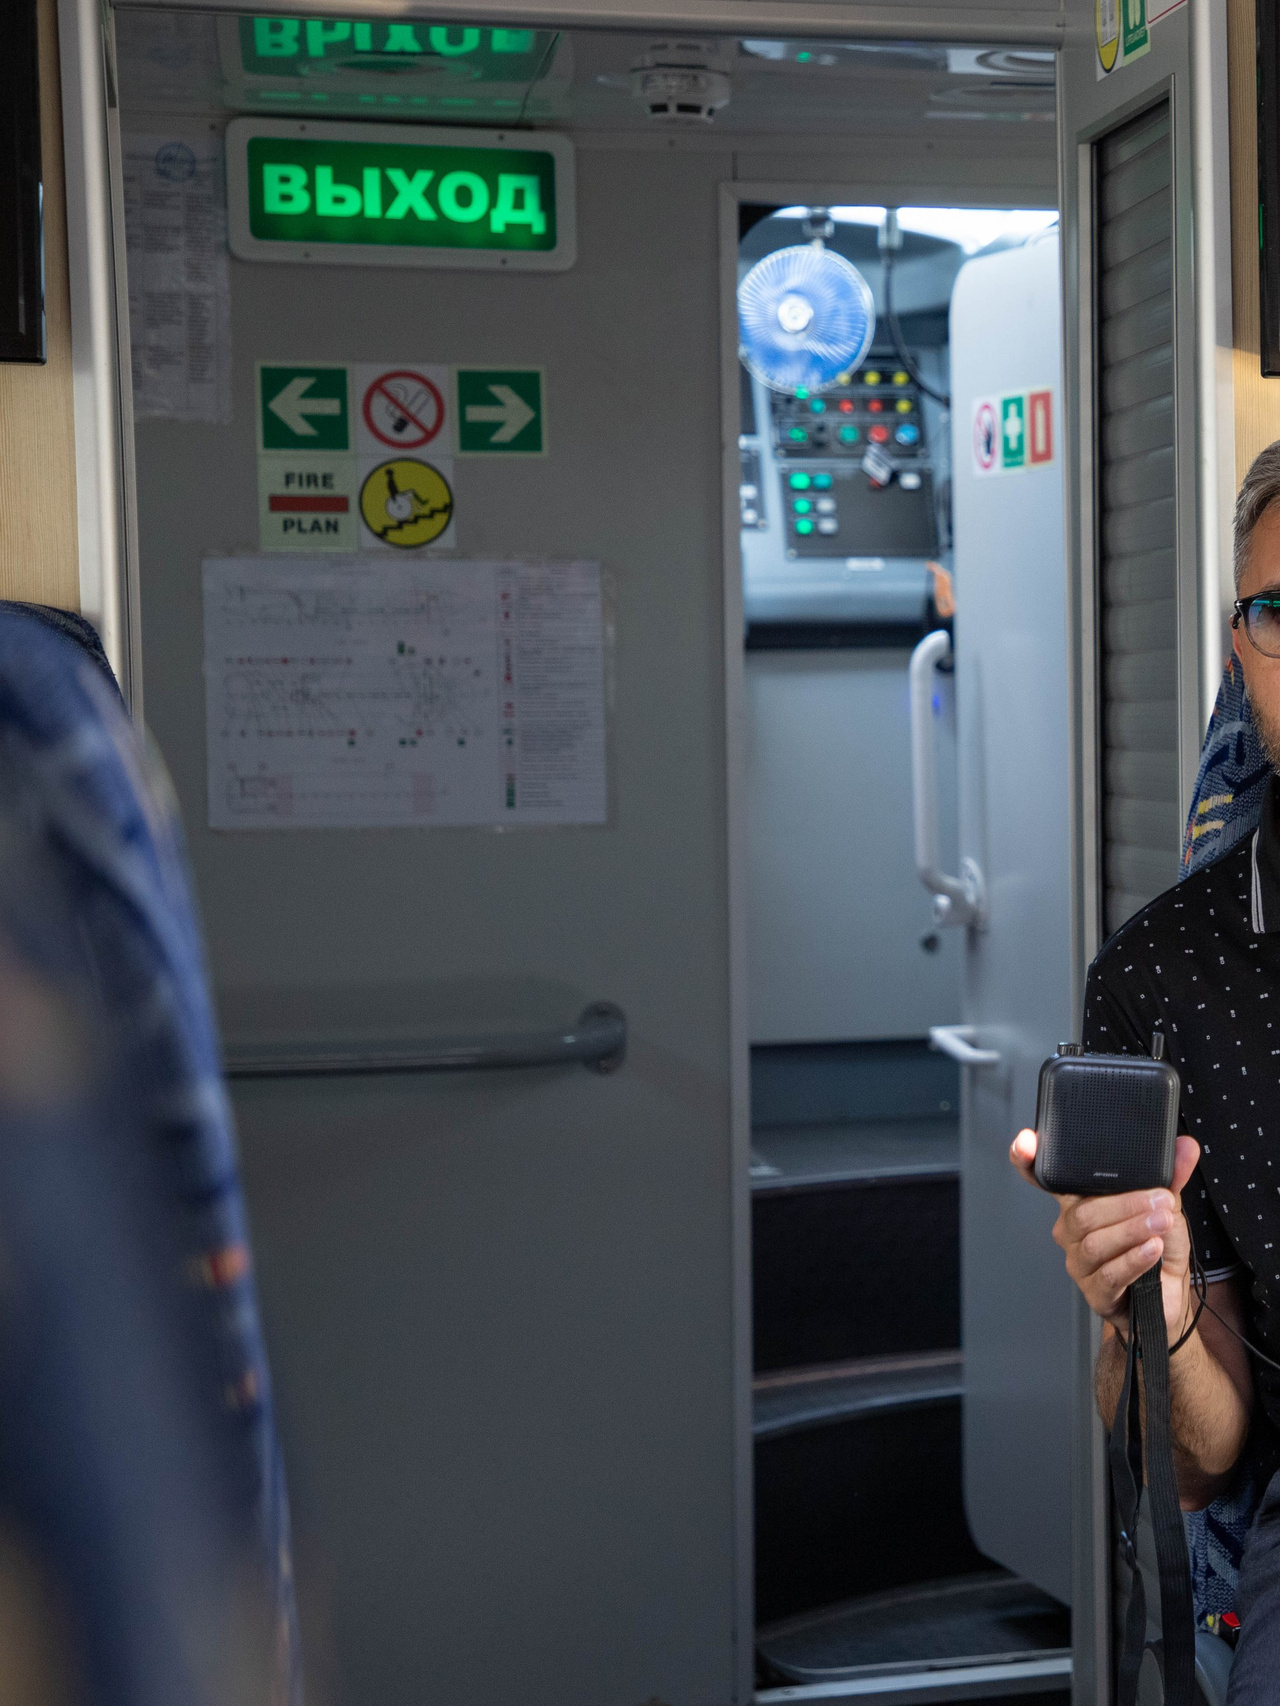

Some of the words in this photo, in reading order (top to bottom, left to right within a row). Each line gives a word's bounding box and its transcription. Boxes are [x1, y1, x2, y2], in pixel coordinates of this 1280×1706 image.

[262, 163, 546, 234] ВЫХОД
[284, 472, 335, 489] FIRE
[282, 517, 339, 533] PLAN
